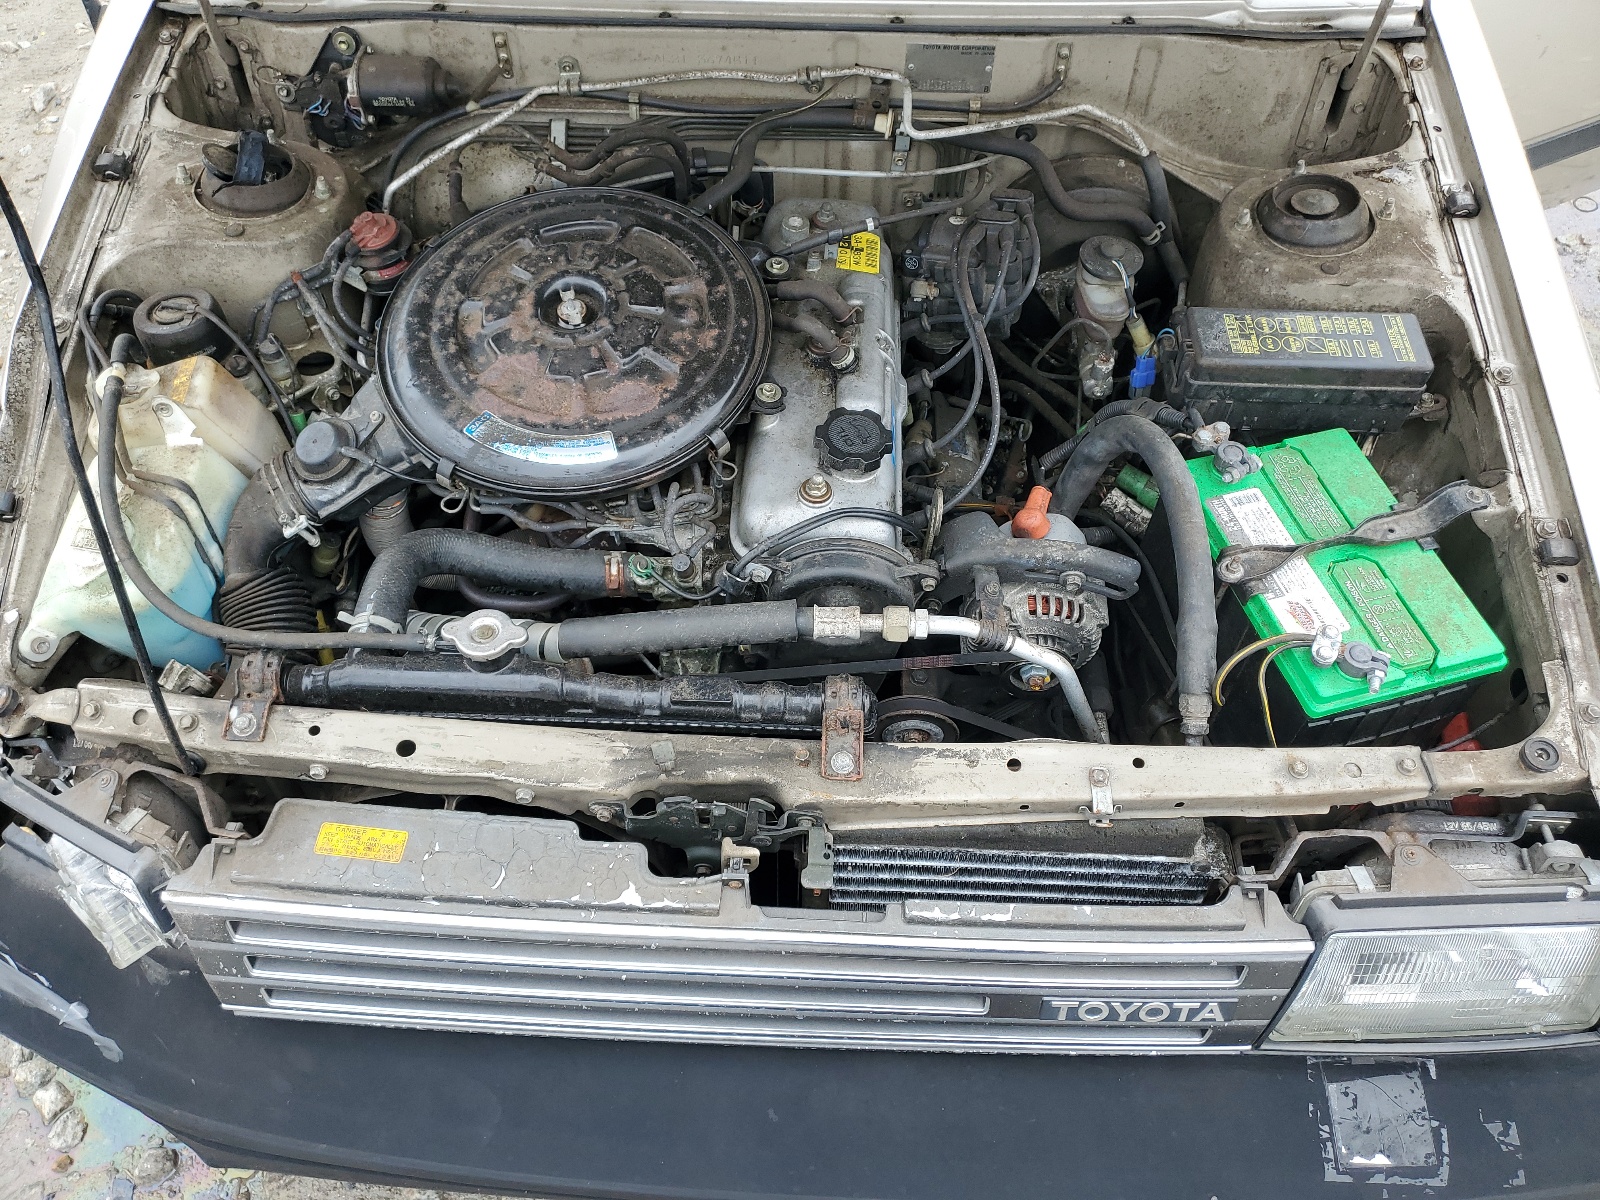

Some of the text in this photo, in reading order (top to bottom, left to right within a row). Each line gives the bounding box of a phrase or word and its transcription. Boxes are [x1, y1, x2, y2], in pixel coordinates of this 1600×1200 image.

[1343, 580, 1366, 606] POISON
[1365, 612, 1389, 642] DANGER
[1051, 1001, 1225, 1023] TOYOTA
